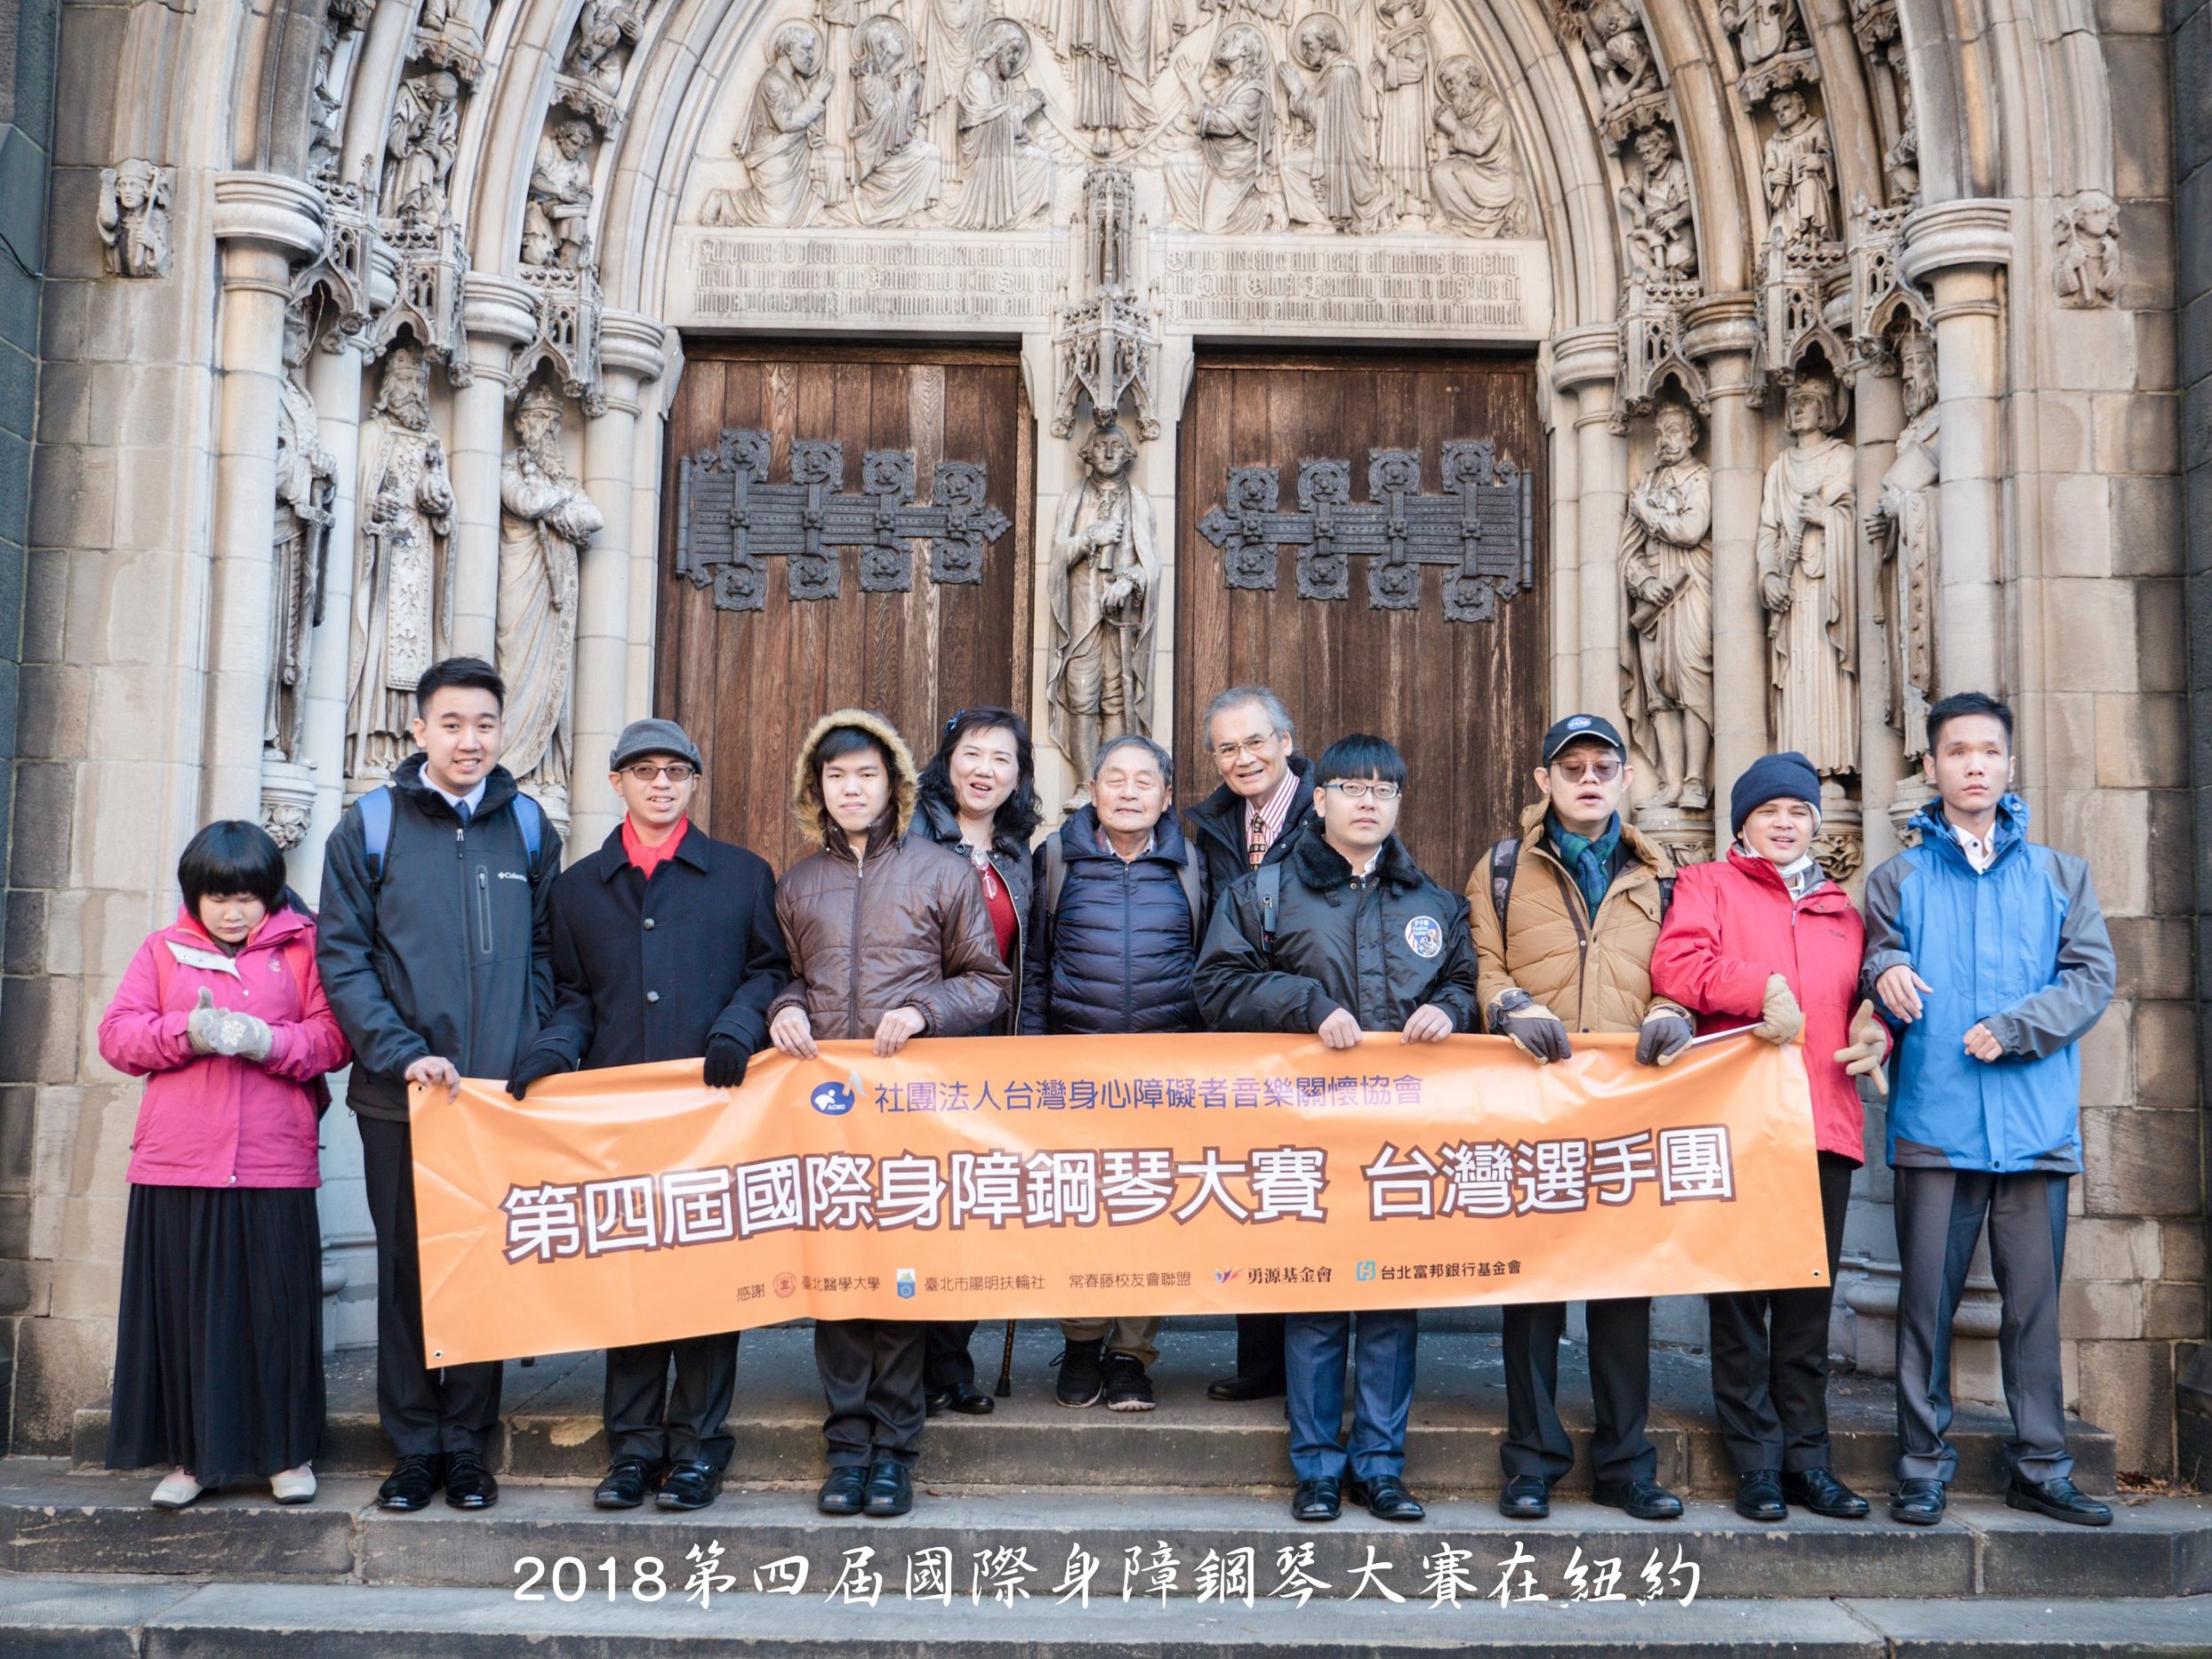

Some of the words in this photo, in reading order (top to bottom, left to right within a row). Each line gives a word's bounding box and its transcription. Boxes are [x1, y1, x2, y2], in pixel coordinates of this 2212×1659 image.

[729, 243, 778, 264] power
[781, 241, 796, 263] is
[978, 243, 1005, 267] and
[1290, 246, 1317, 272] and
[779, 268, 819, 288] name
[998, 269, 1034, 294] Son
[874, 1074, 1424, 1113] 社團法人台灣身心障礙者音樂關懷協會
[502, 1145, 1328, 1262] 第四屆國際身障鋼琴大賽
[1361, 1125, 1736, 1221] 台灣選手團
[736, 1283, 765, 1302] 感謝
[802, 1275, 880, 1292] 臺北醫學大學
[924, 1274, 1045, 1292] 臺北市陽明扶輪社
[1069, 1272, 1191, 1289] 常春藤校友會聯盟
[1247, 1265, 1332, 1285] 勇源基金會
[1380, 1259, 1521, 1280] 台北富邦銀行基金會
